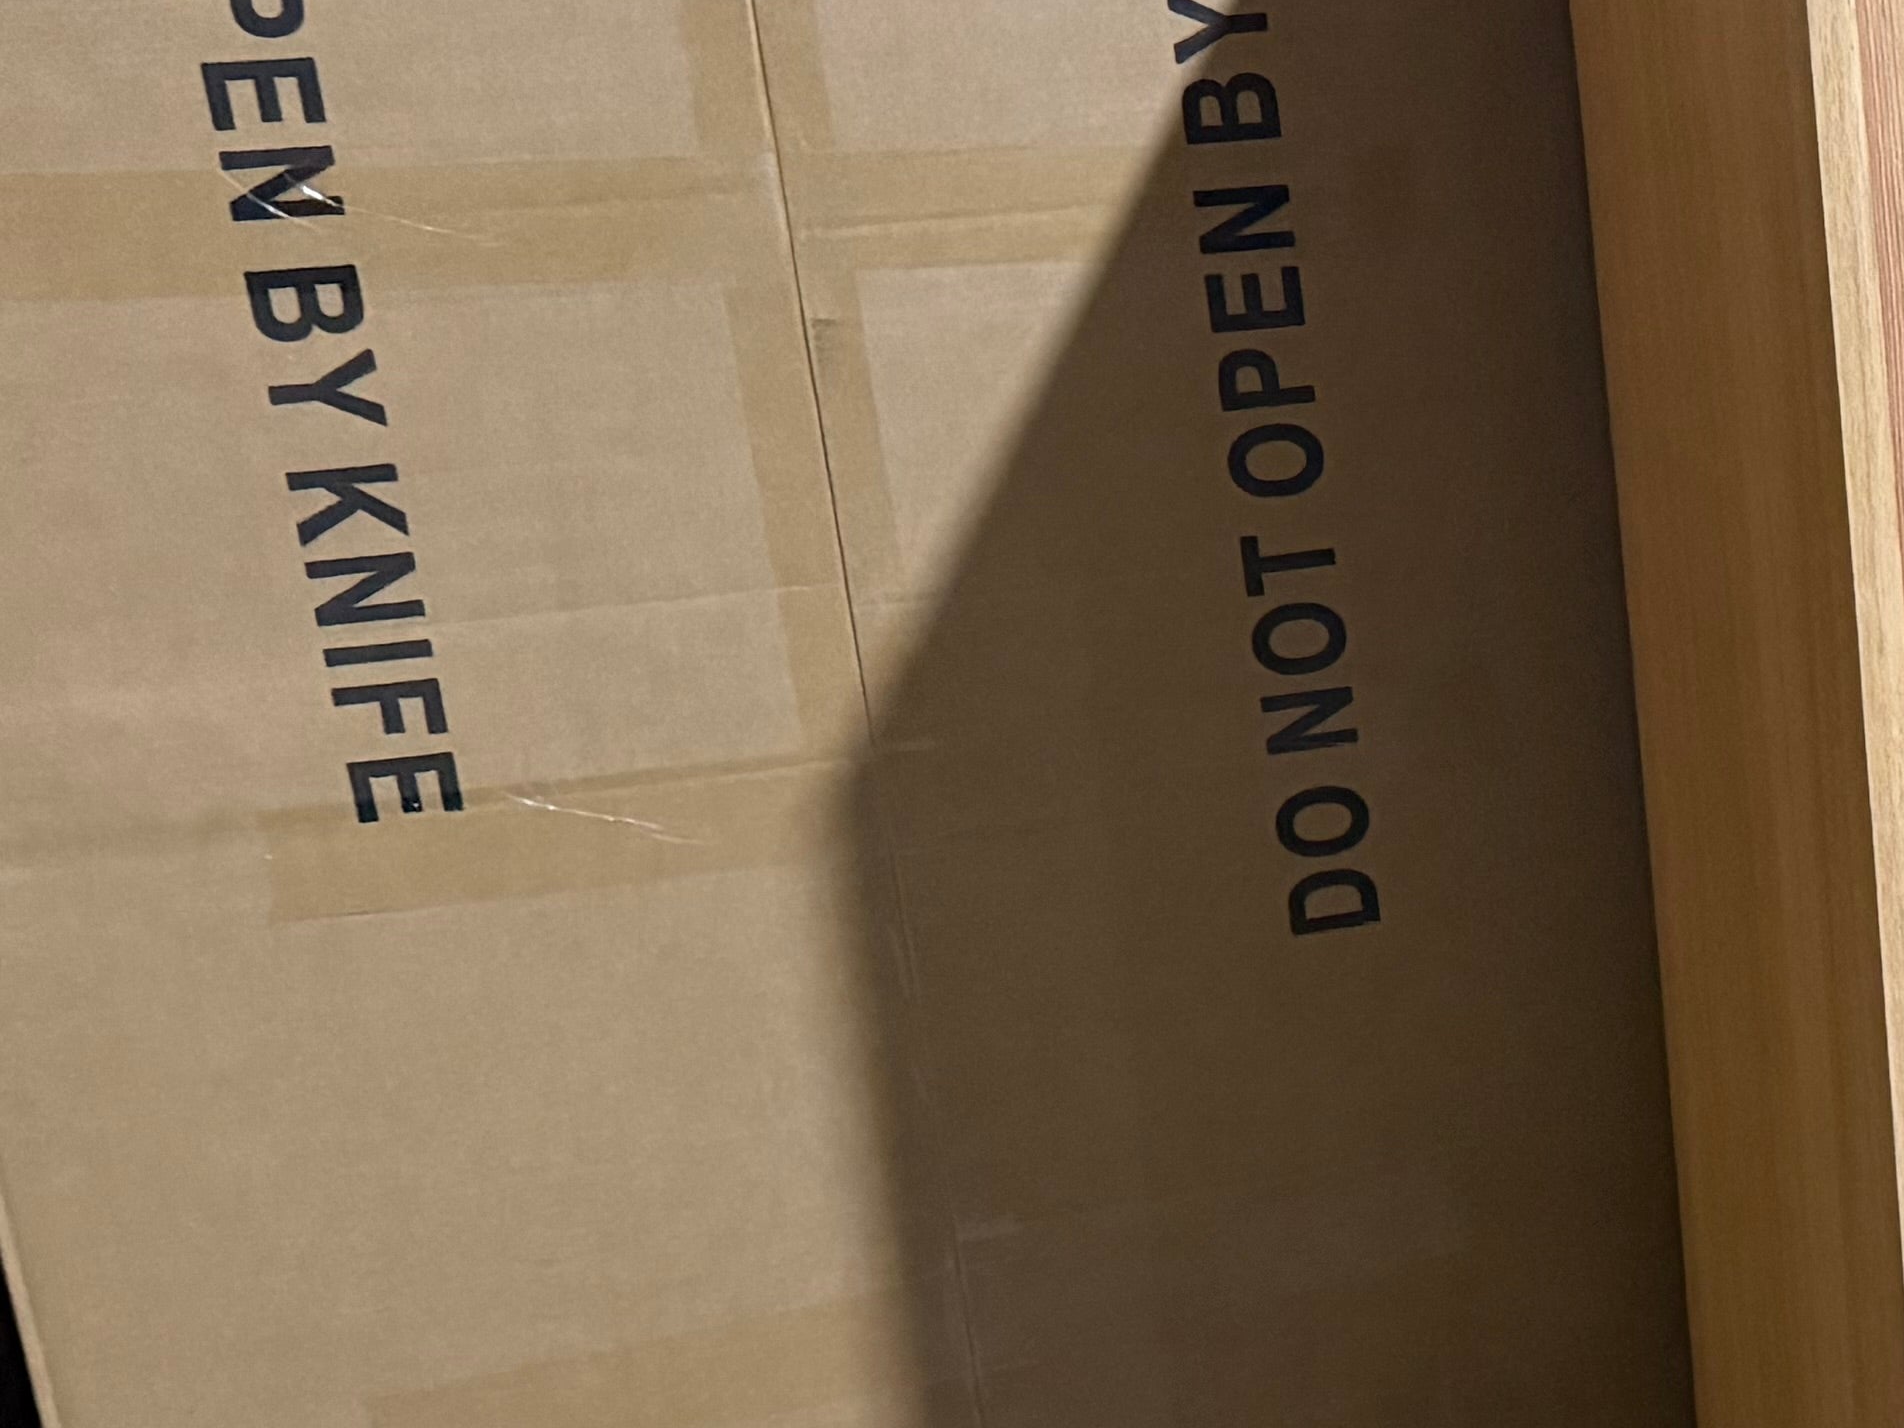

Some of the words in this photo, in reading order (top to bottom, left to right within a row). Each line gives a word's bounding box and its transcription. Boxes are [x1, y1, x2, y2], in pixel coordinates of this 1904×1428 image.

[242, 263, 389, 428] BY
[1192, 184, 1326, 498] OPEN
[285, 460, 465, 824] KNIFE
[1239, 533, 1360, 753] NOT
[1274, 785, 1381, 939] DO
